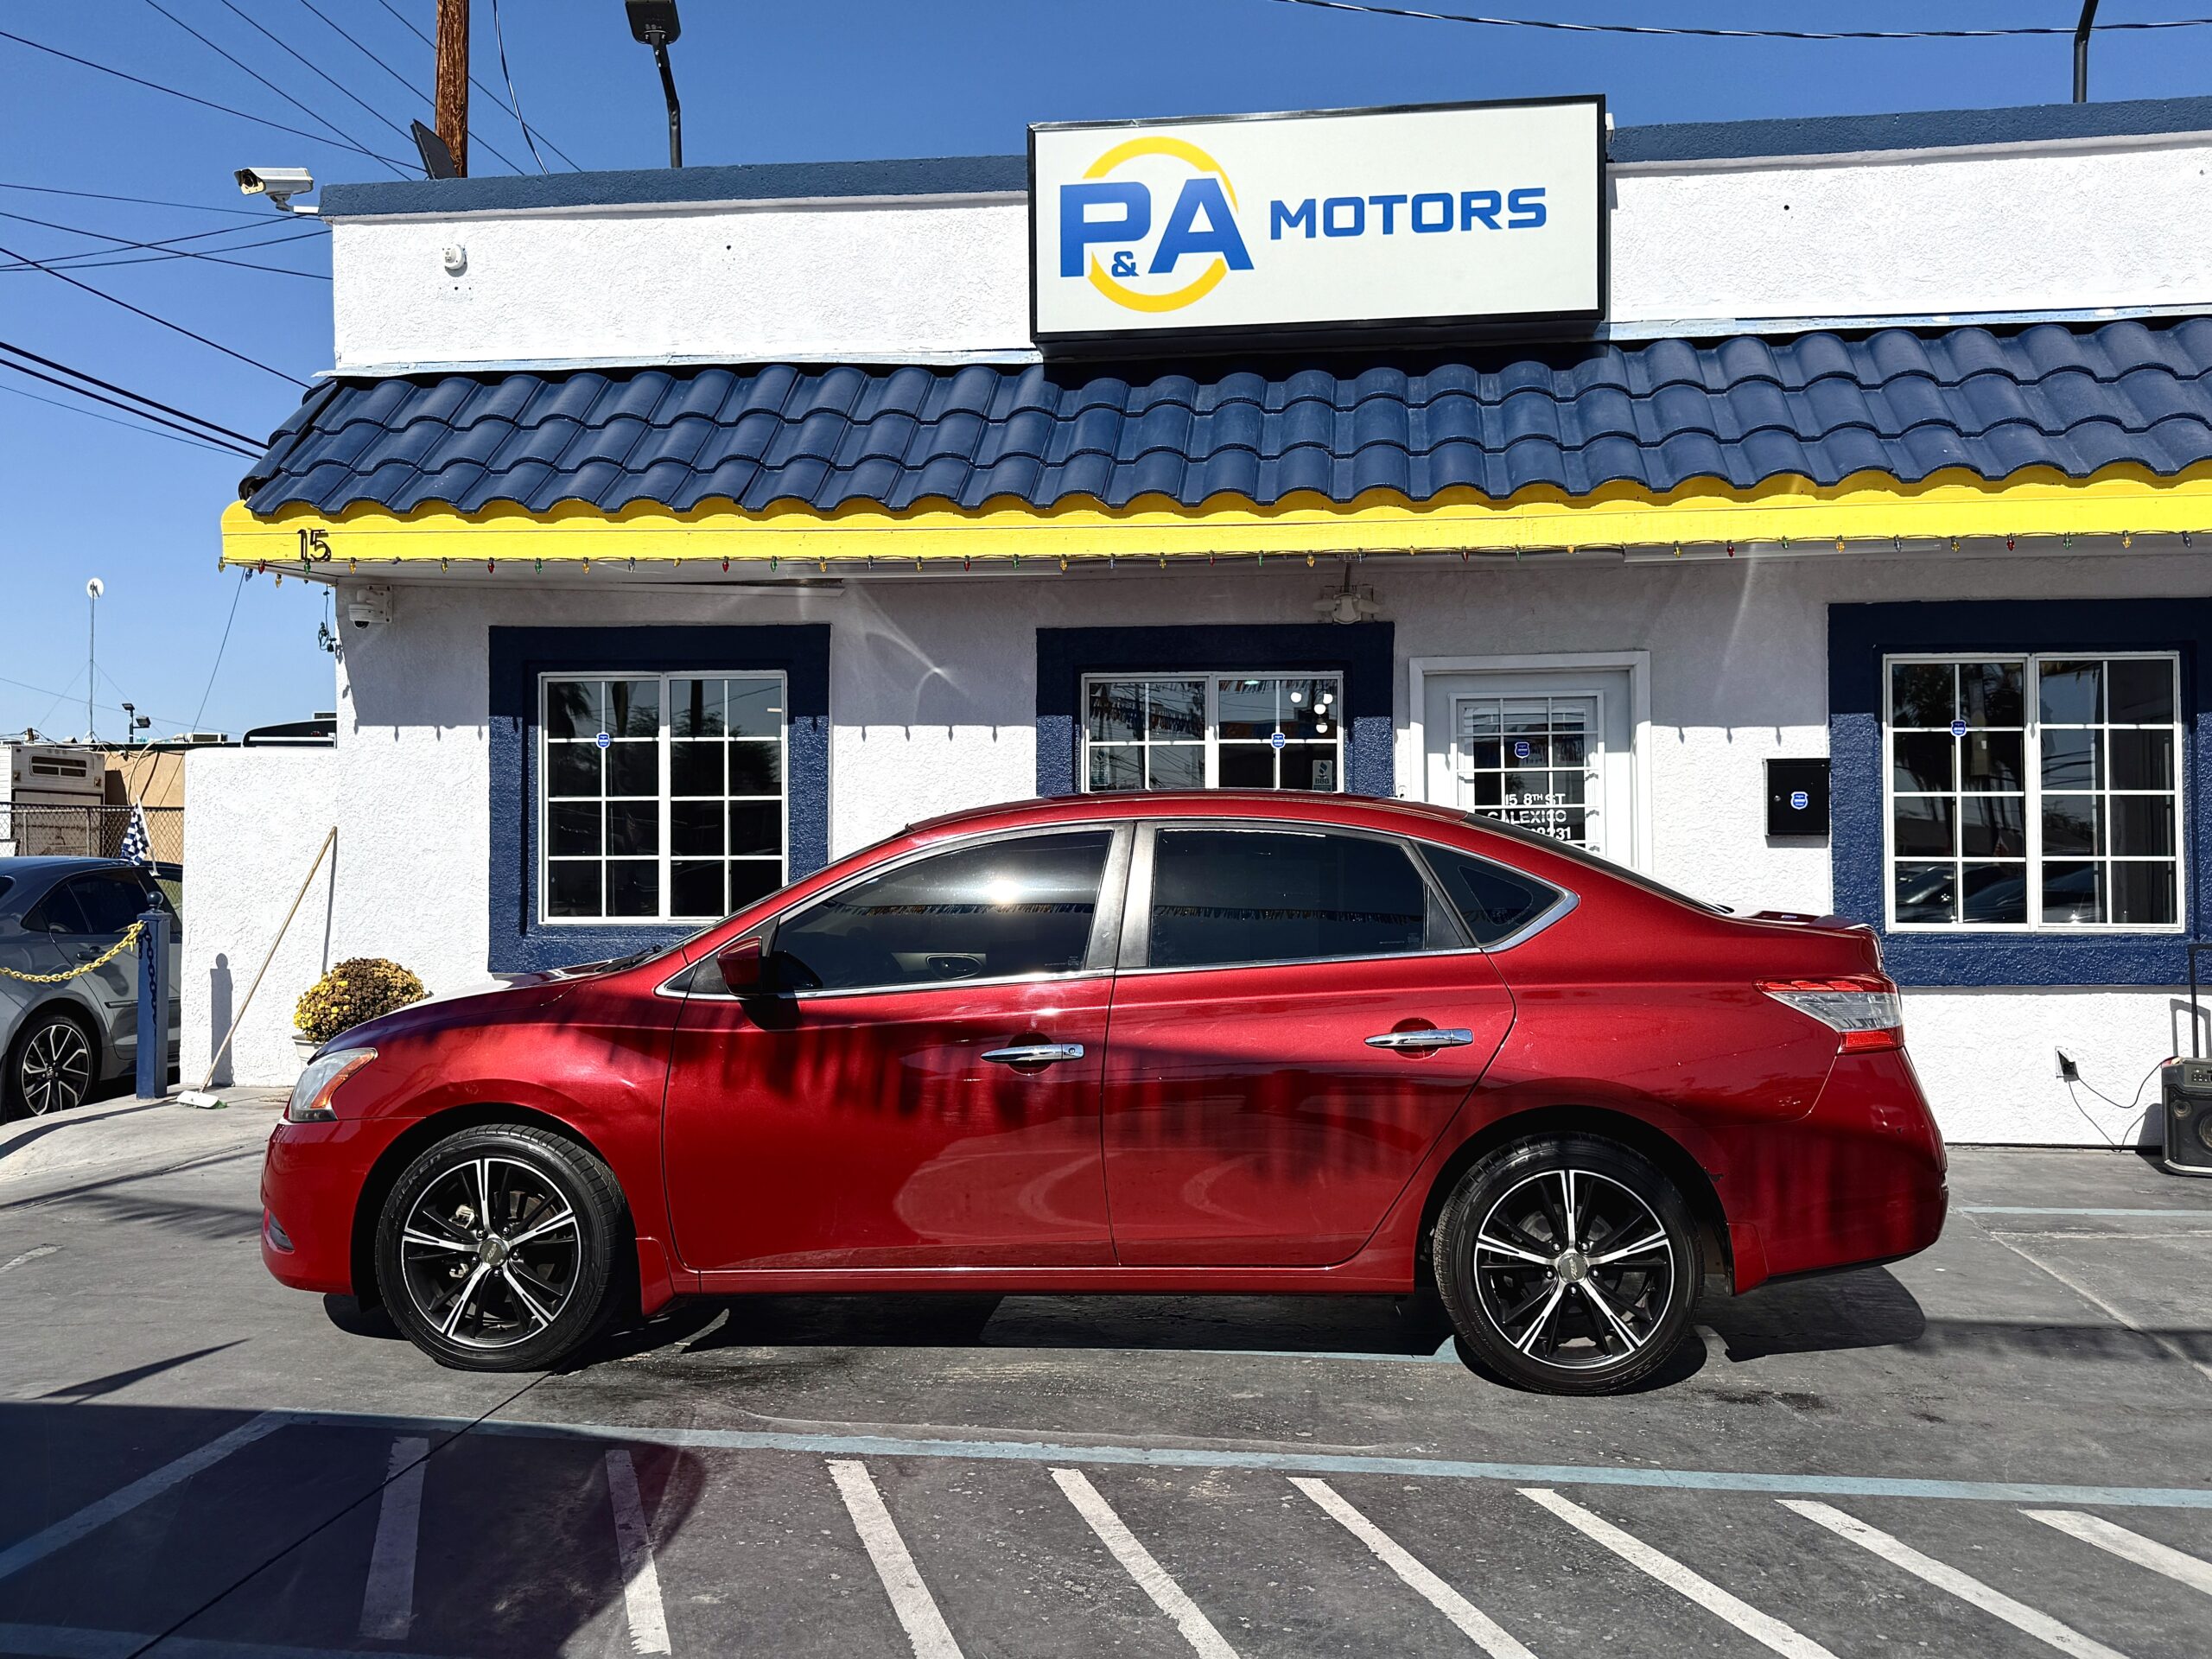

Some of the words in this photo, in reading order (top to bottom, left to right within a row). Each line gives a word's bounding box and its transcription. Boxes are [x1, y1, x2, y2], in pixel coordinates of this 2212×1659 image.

[1269, 188, 1547, 240] MOTORS
[297, 529, 332, 562] 15
[1505, 793, 1518, 805] 15
[1523, 793, 1543, 805] 8TH
[1545, 793, 1566, 805] ST
